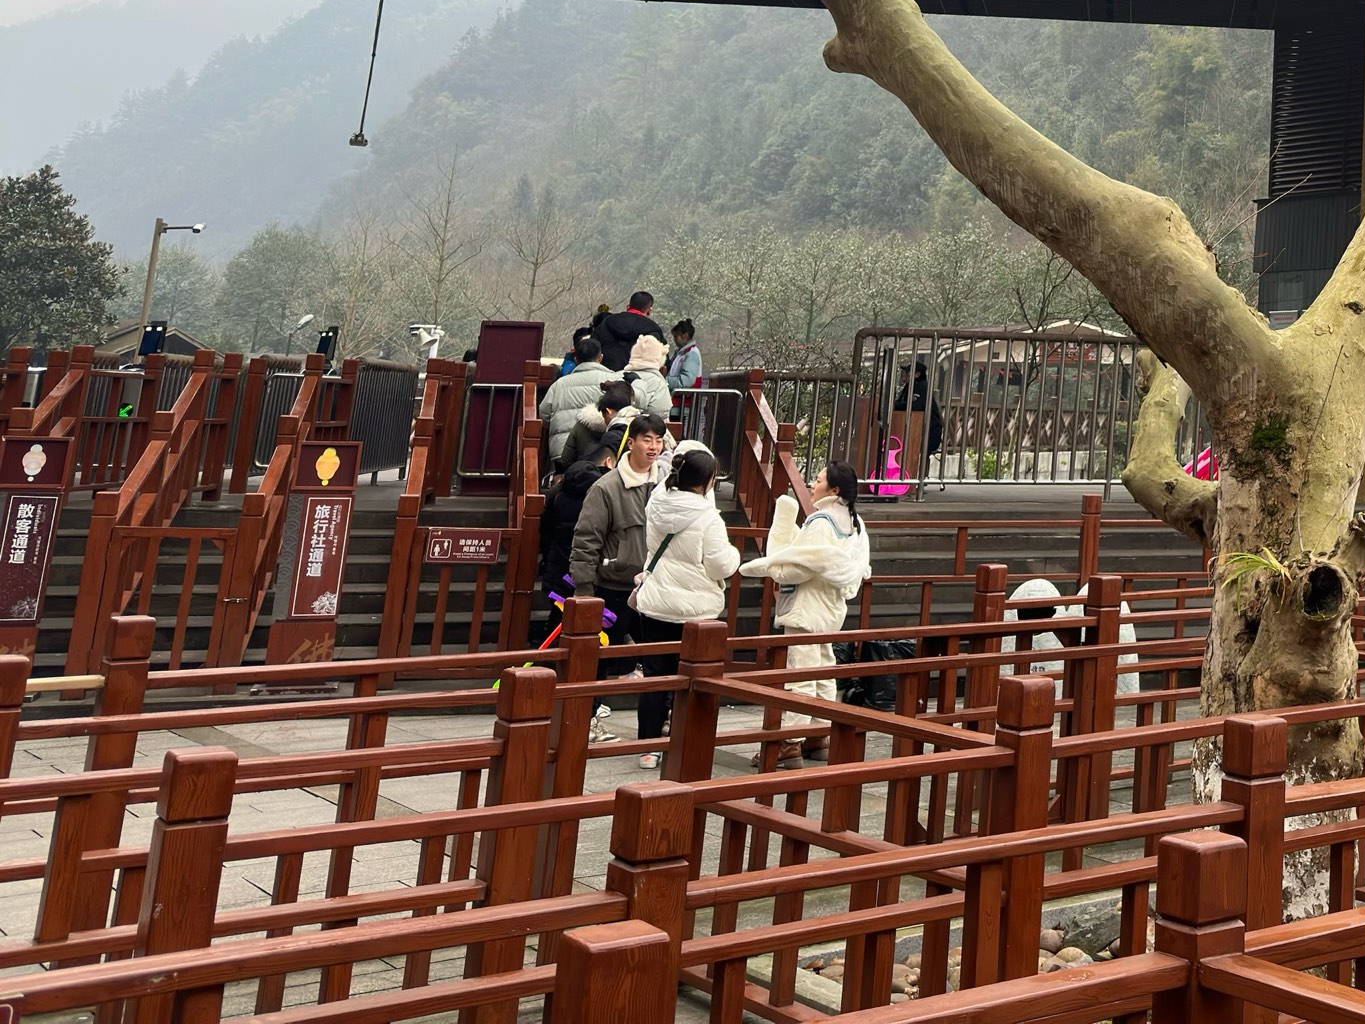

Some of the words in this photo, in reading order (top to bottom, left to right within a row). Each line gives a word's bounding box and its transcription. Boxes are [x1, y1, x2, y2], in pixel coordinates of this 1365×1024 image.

[8, 503, 36, 564] 散客通道
[306, 504, 331, 577] 旅行社通道
[328, 521, 337, 540] Agency
